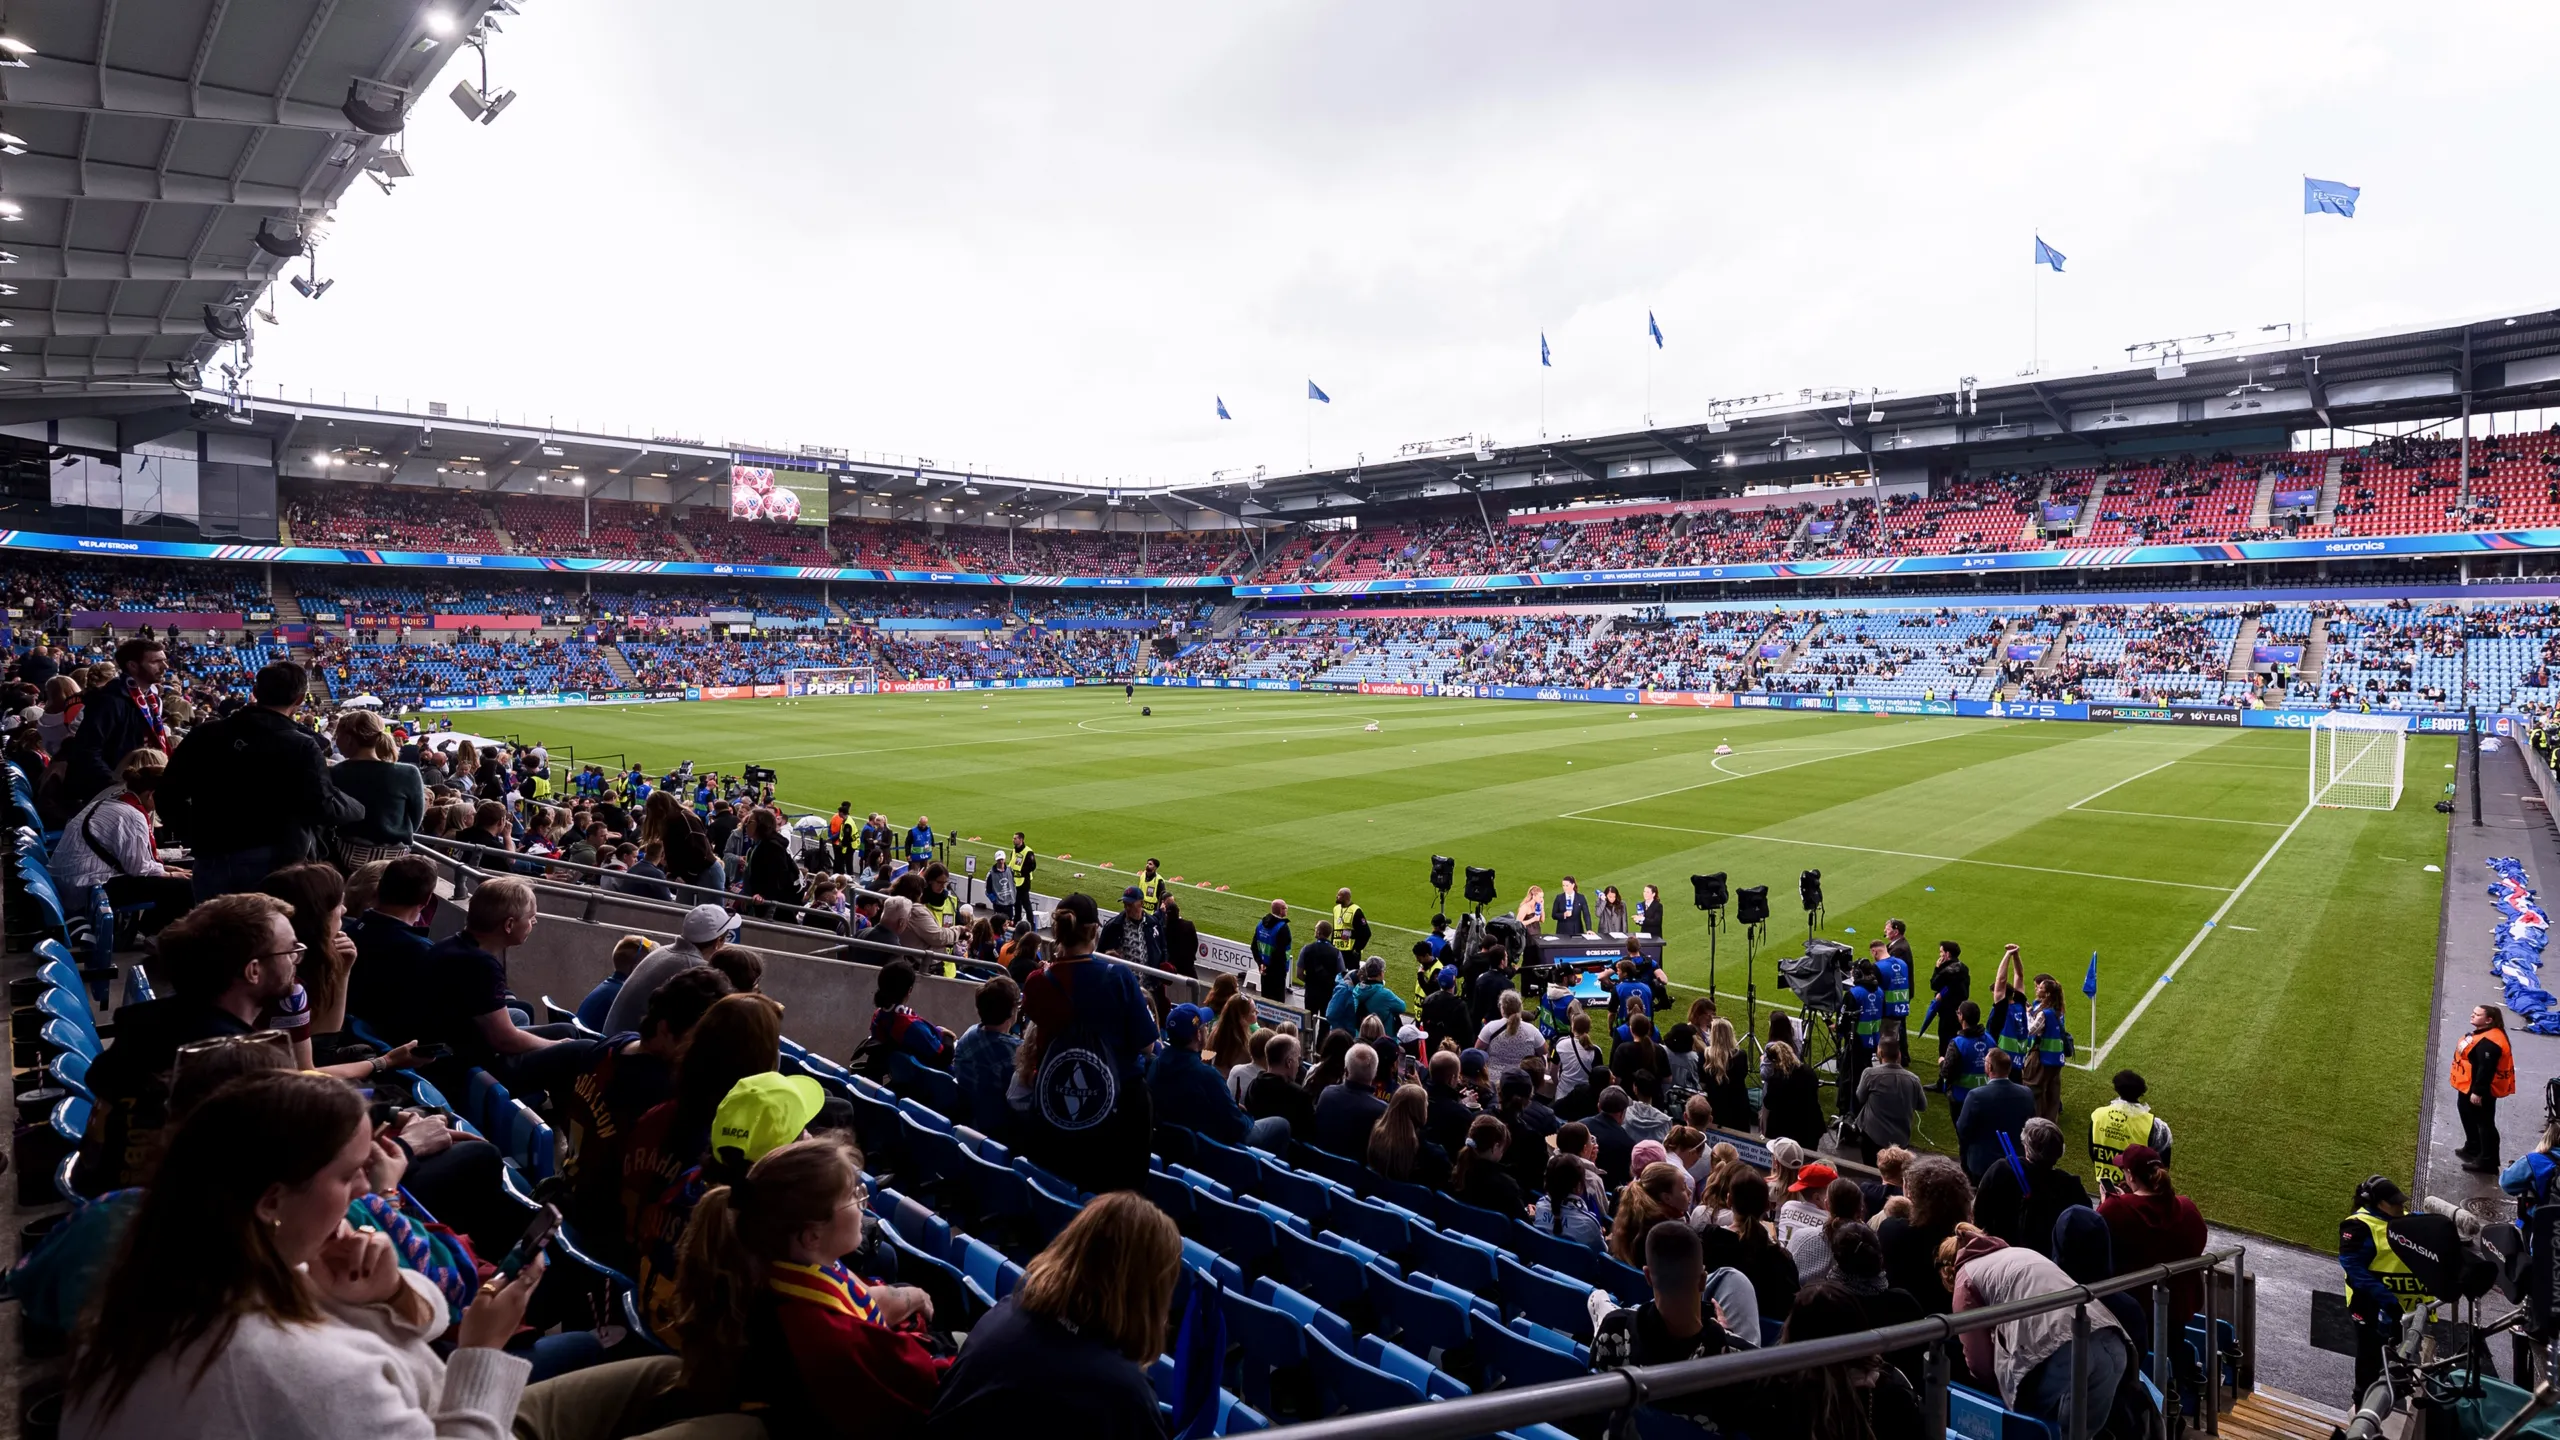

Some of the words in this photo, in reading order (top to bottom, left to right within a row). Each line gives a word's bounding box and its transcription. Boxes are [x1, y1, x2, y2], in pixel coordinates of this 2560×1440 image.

[2313, 191, 2348, 206] RESECT
[90, 541, 107, 549] PLAY
[107, 542, 139, 551] STRONG
[2333, 540, 2386, 552] euronics
[456, 556, 483, 565] RESPECT
[1973, 558, 1996, 566] PS5
[1642, 570, 1677, 579] CHAMPIONS
[1678, 569, 1701, 577] LEAGUE
[354, 616, 388, 626] SOM-HI
[401, 616, 429, 626] NOIES!
[894, 682, 935, 692] vodafone
[1027, 679, 1064, 688] euronics
[1256, 681, 1291, 690] euronics
[807, 683, 850, 695] PEPSI
[1371, 684, 1409, 694] vodafone
[1438, 685, 1475, 697] PEPSI
[507, 694, 526, 703] Every
[526, 693, 545, 701] match
[1563, 692, 1590, 700] FINAL
[1647, 691, 1678, 700] amazon
[1693, 692, 1726, 702] amazon
[430, 700, 473, 708] RECYCLE
[509, 699, 526, 707] Only
[1740, 696, 1770, 706] WELCOME
[1769, 696, 1783, 707] ALL
[1795, 697, 1834, 709] #FOOTBALL
[1867, 698, 1886, 706] Every
[1886, 699, 1908, 707] match
[1908, 699, 1923, 707] live.
[1869, 704, 1885, 713] Only
[1896, 704, 1922, 713] Disney+
[2010, 704, 2057, 717] PS5
[2091, 709, 2112, 717] UEFA
[2113, 708, 2171, 719] FOUNDATION
[1211, 947, 1254, 969] RESPECT
[1893, 991, 1909, 1002] TV
[1055, 1082, 1099, 1097] SKECHERS
[721, 1126, 750, 1139] BARÇA
[2388, 1229, 2439, 1263] WISYCOM
